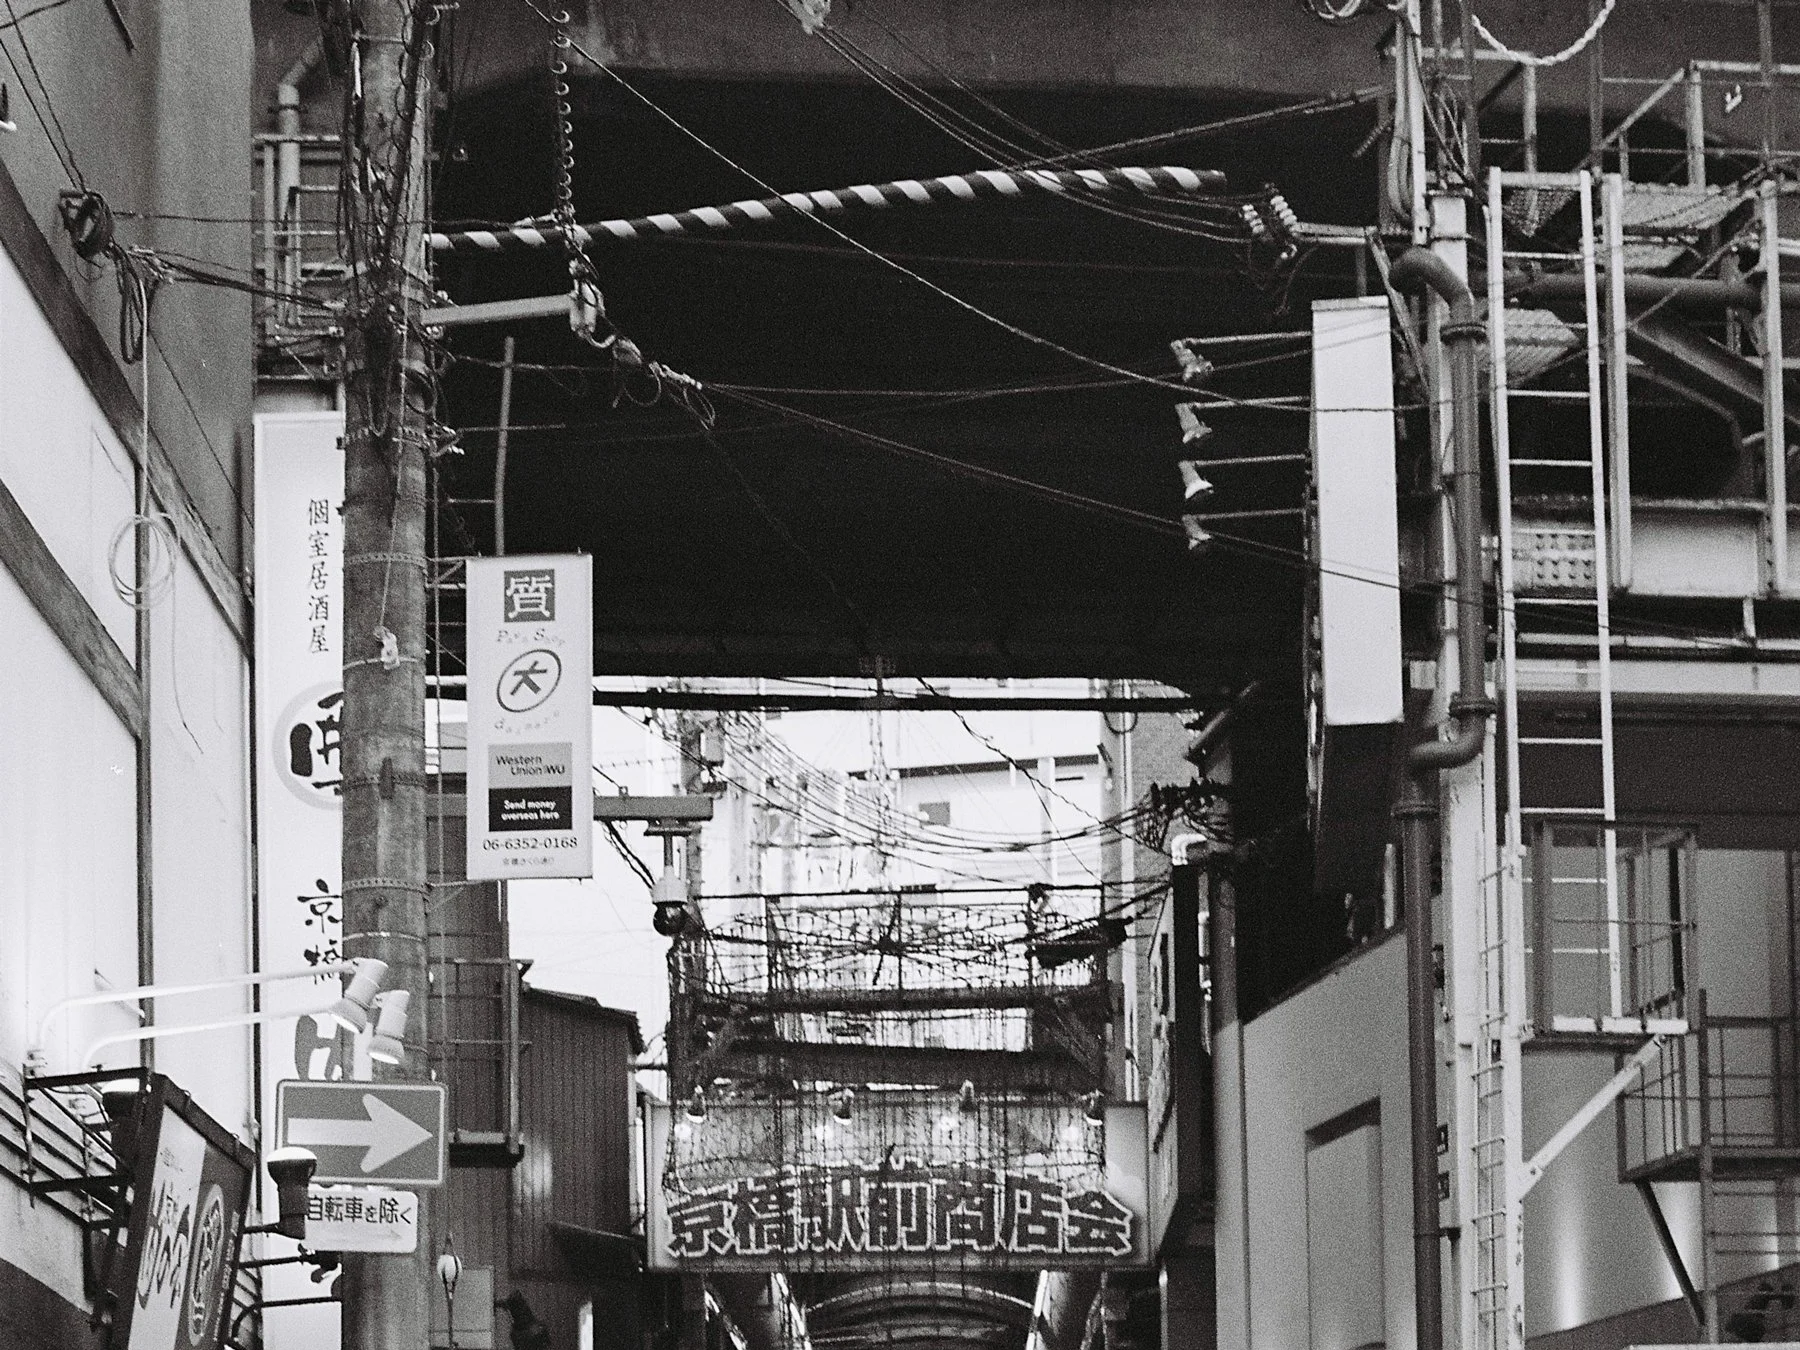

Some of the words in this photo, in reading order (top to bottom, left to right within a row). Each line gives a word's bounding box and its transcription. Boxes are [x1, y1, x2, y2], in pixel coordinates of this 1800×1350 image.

[308, 498, 330, 654] 個室居酒屋
[506, 575, 552, 619] 質
[496, 755, 543, 766] Western
[511, 765, 543, 776] Union
[504, 799, 526, 810] Send
[527, 800, 556, 810] money
[501, 812, 538, 821] overseas
[540, 810, 560, 820] here
[482, 836, 578, 851] 06-6352-0168
[308, 1194, 412, 1225] 自転車を除く
[667, 1158, 1134, 1257] 京橋駅前商店会
